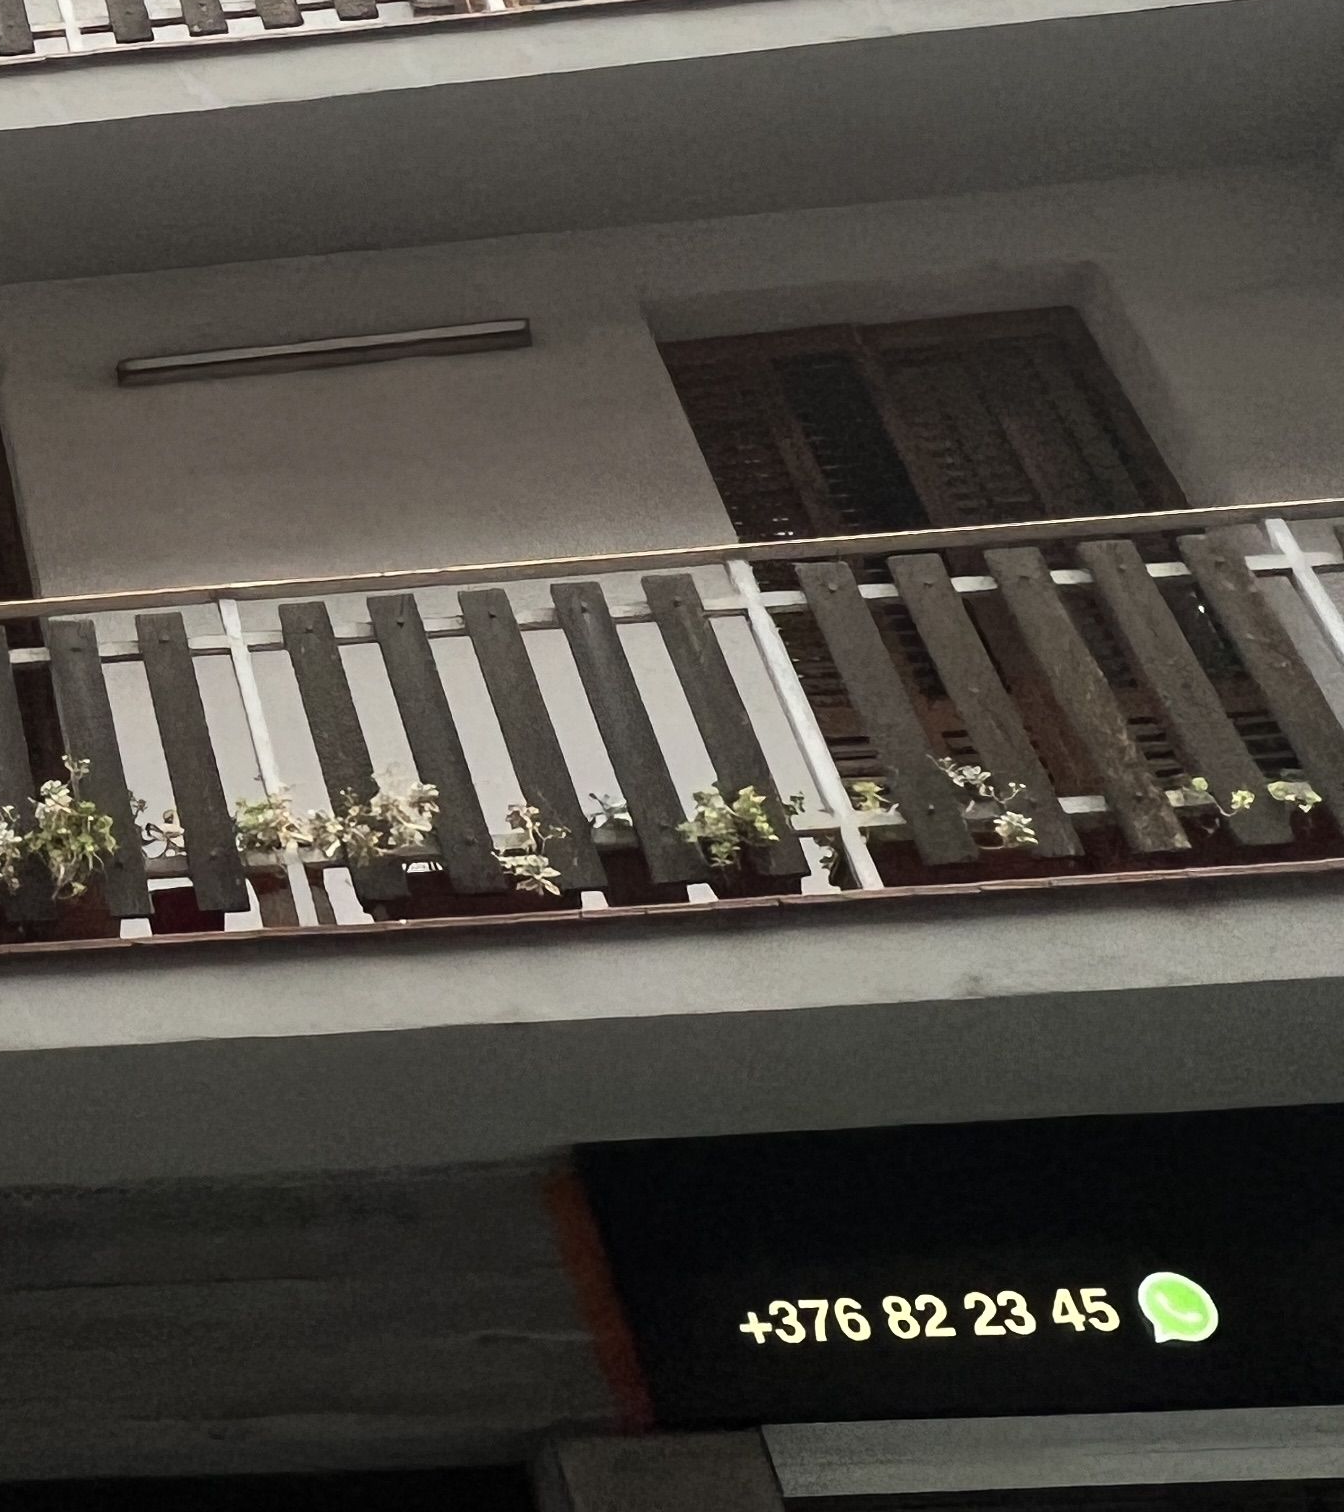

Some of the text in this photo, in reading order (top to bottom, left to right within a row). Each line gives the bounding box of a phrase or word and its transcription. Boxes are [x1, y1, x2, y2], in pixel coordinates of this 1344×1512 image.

[738, 1286, 1122, 1346] +376 82 23 45
